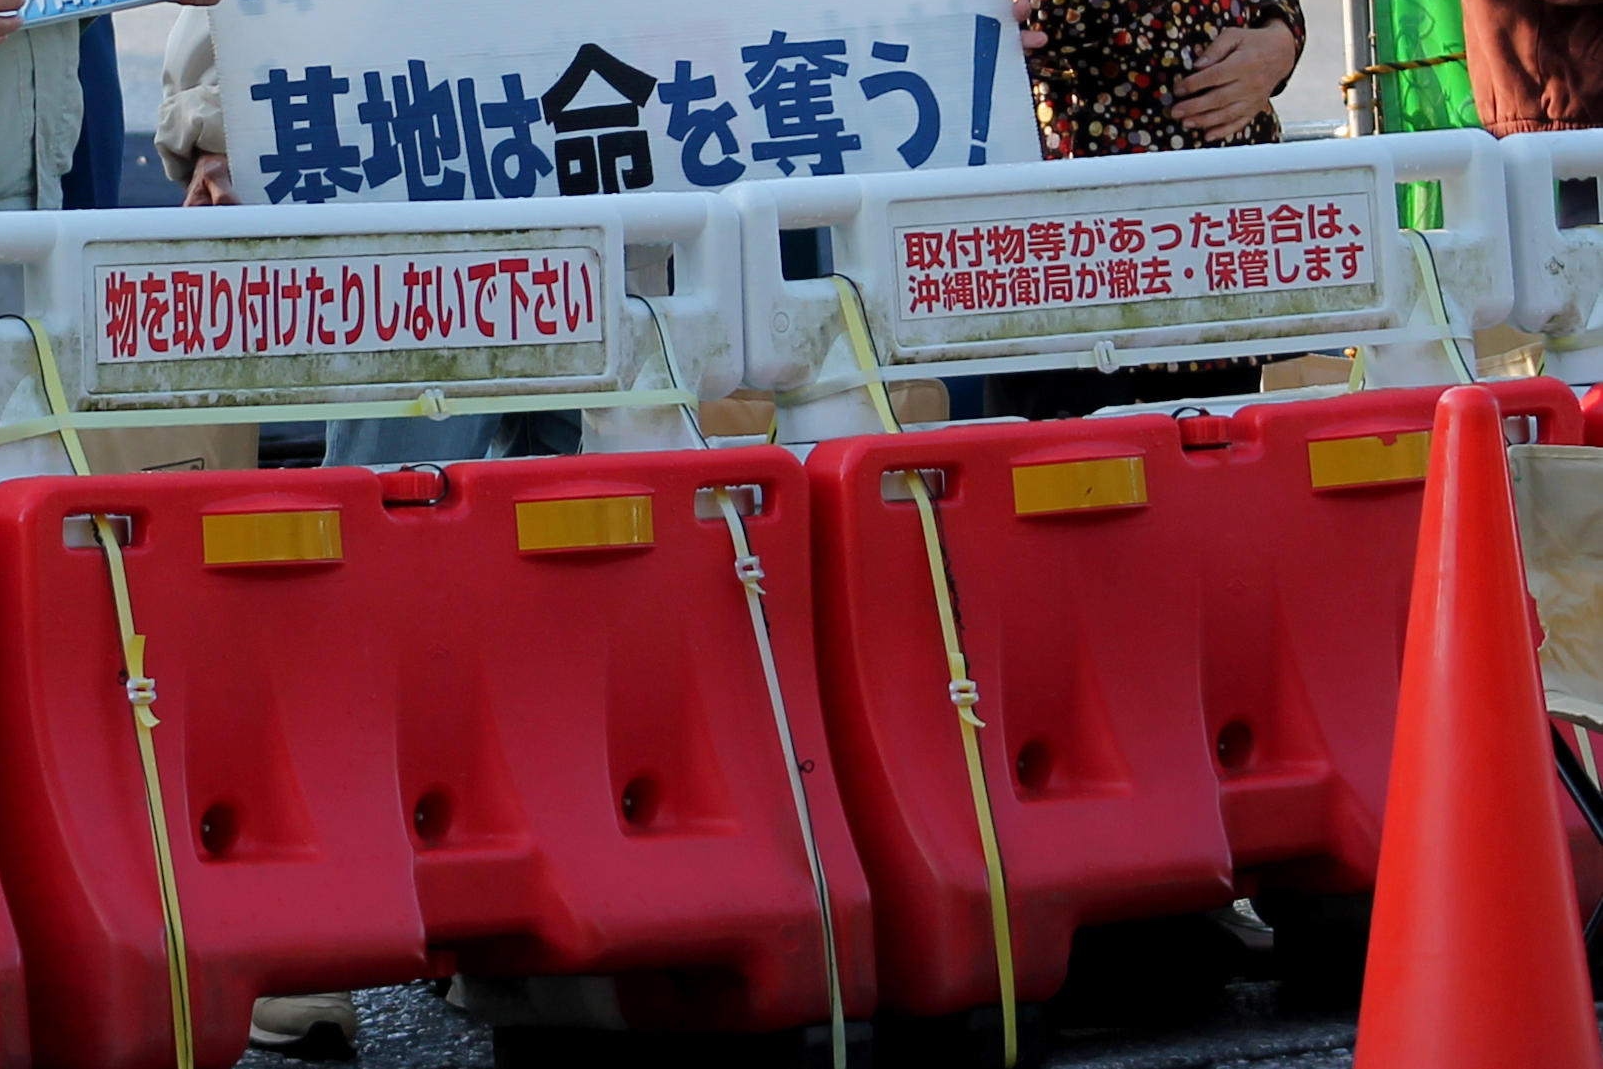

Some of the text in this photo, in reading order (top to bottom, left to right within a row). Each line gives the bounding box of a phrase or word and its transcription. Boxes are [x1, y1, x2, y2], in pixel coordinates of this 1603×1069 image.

[903, 202, 1363, 271] 取付物等があった場合は、
[105, 256, 594, 358] 物を取り付けたりしないで下さい
[906, 241, 1365, 314] 沖縄防衛局が撤去・保管します
